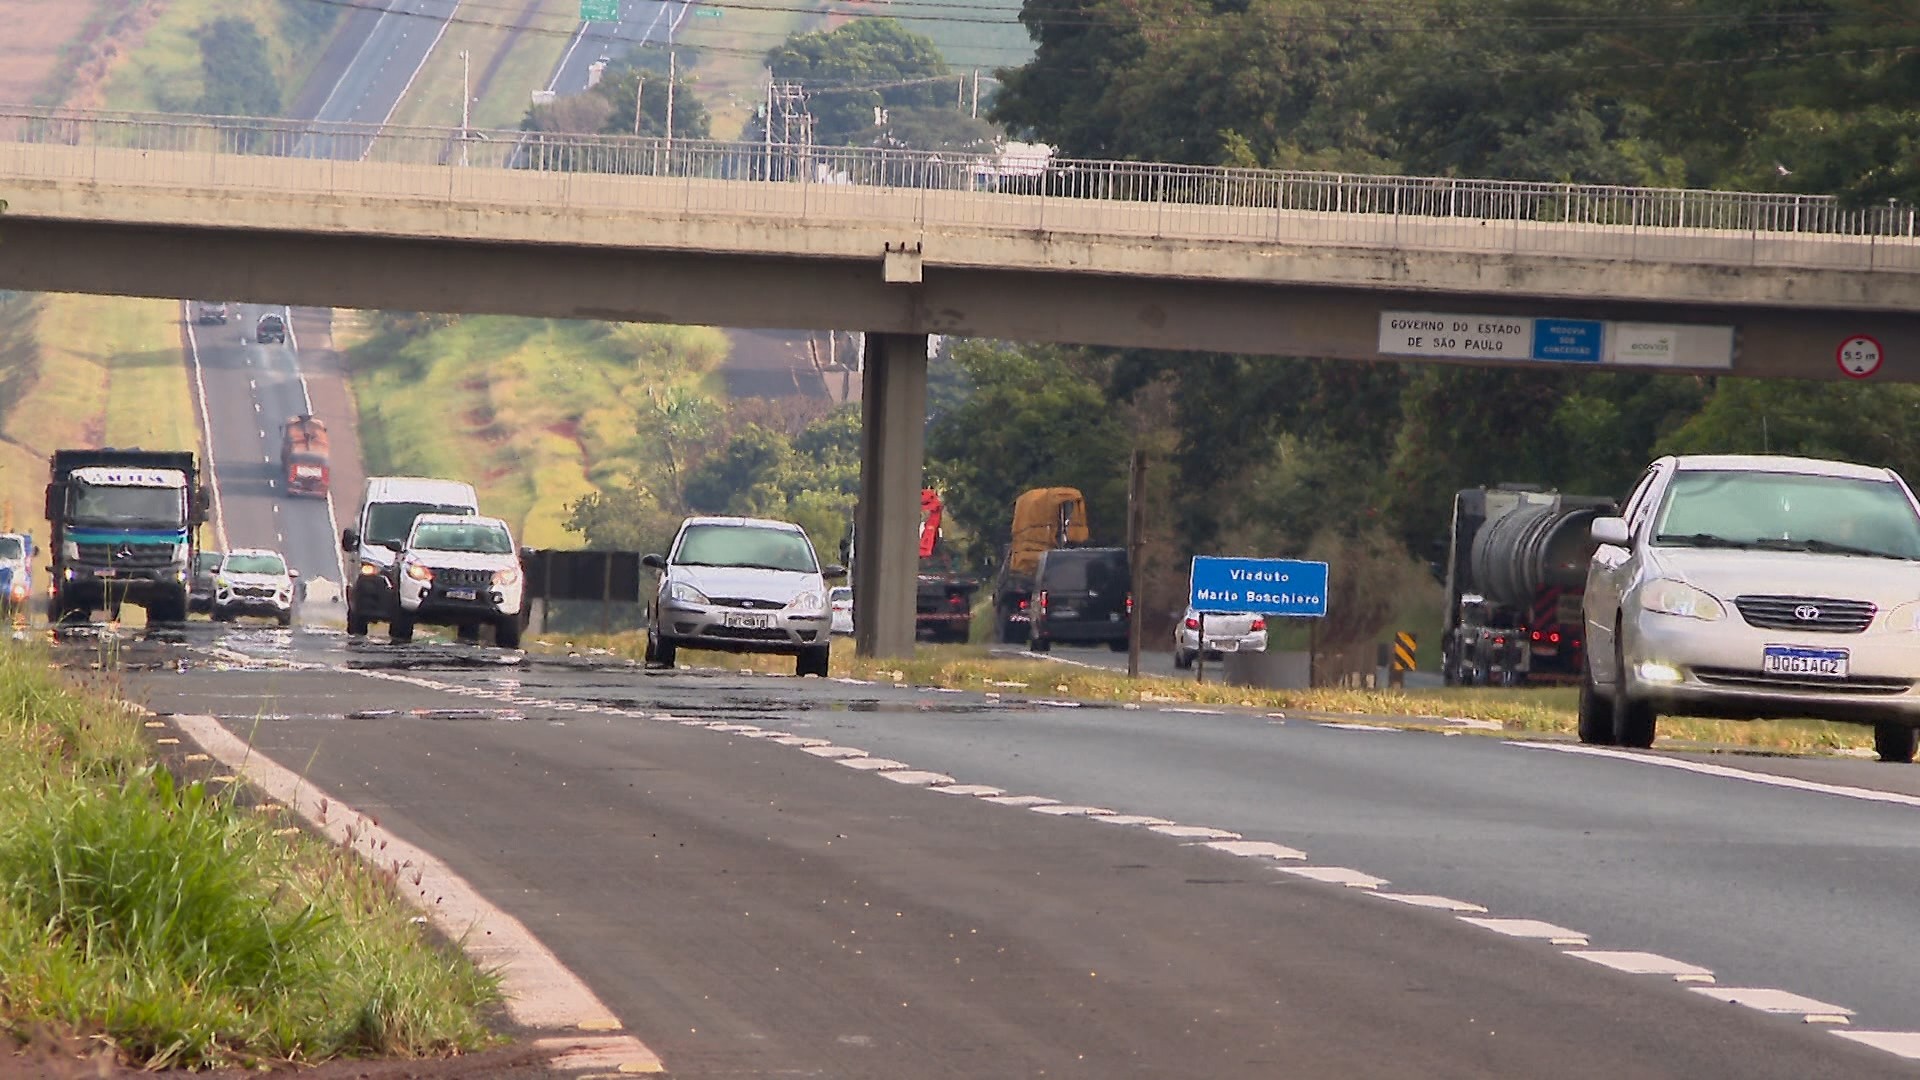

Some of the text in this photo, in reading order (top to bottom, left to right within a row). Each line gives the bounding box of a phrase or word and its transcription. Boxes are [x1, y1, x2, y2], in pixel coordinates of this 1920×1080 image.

[1391, 319, 1521, 335] GOVERNO DO ESTADO
[1407, 337, 1503, 351] DE SÃO PAULO
[1230, 569, 1289, 582] Viaduto
[1197, 588, 1319, 604] Mario Boschiero
